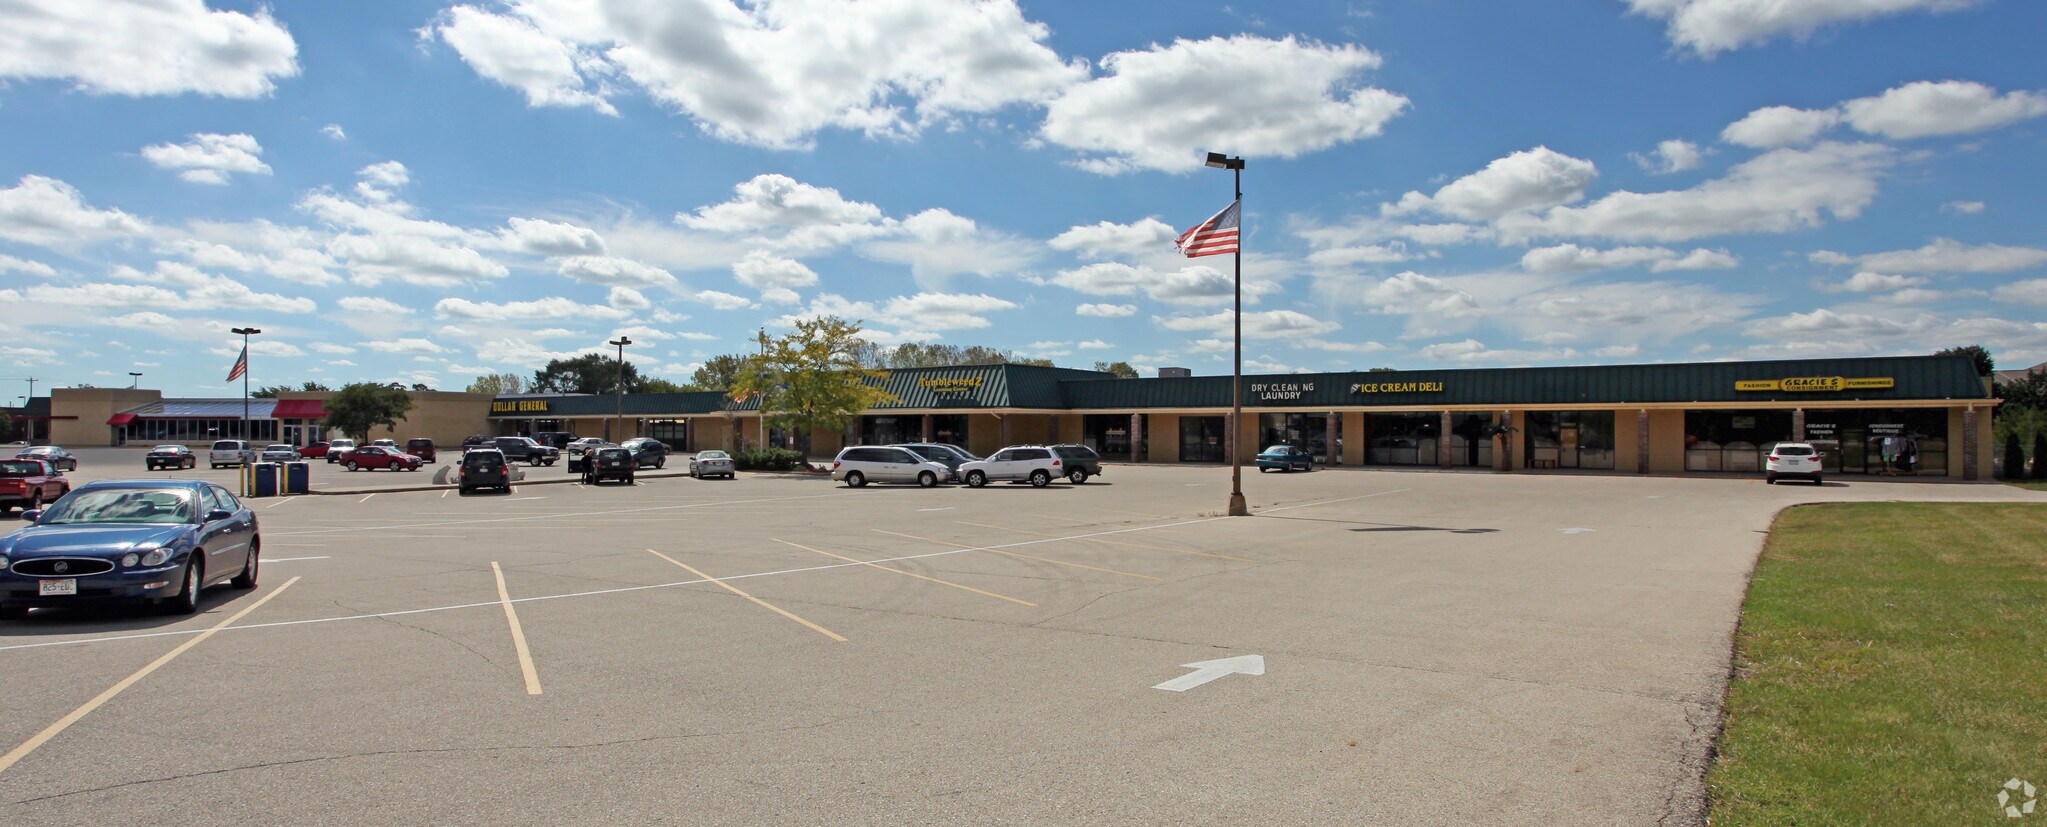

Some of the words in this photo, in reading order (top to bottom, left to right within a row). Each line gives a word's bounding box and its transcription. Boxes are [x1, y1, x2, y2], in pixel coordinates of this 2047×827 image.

[1251, 383, 1268, 392] DRY
[1361, 383, 1379, 393] ICE
[1380, 382, 1417, 393] CREAM
[1419, 382, 1443, 392] DELI
[1261, 391, 1301, 400] LAUNDRY
[493, 401, 516, 412] DOLLAR
[519, 400, 548, 411] GENERAL
